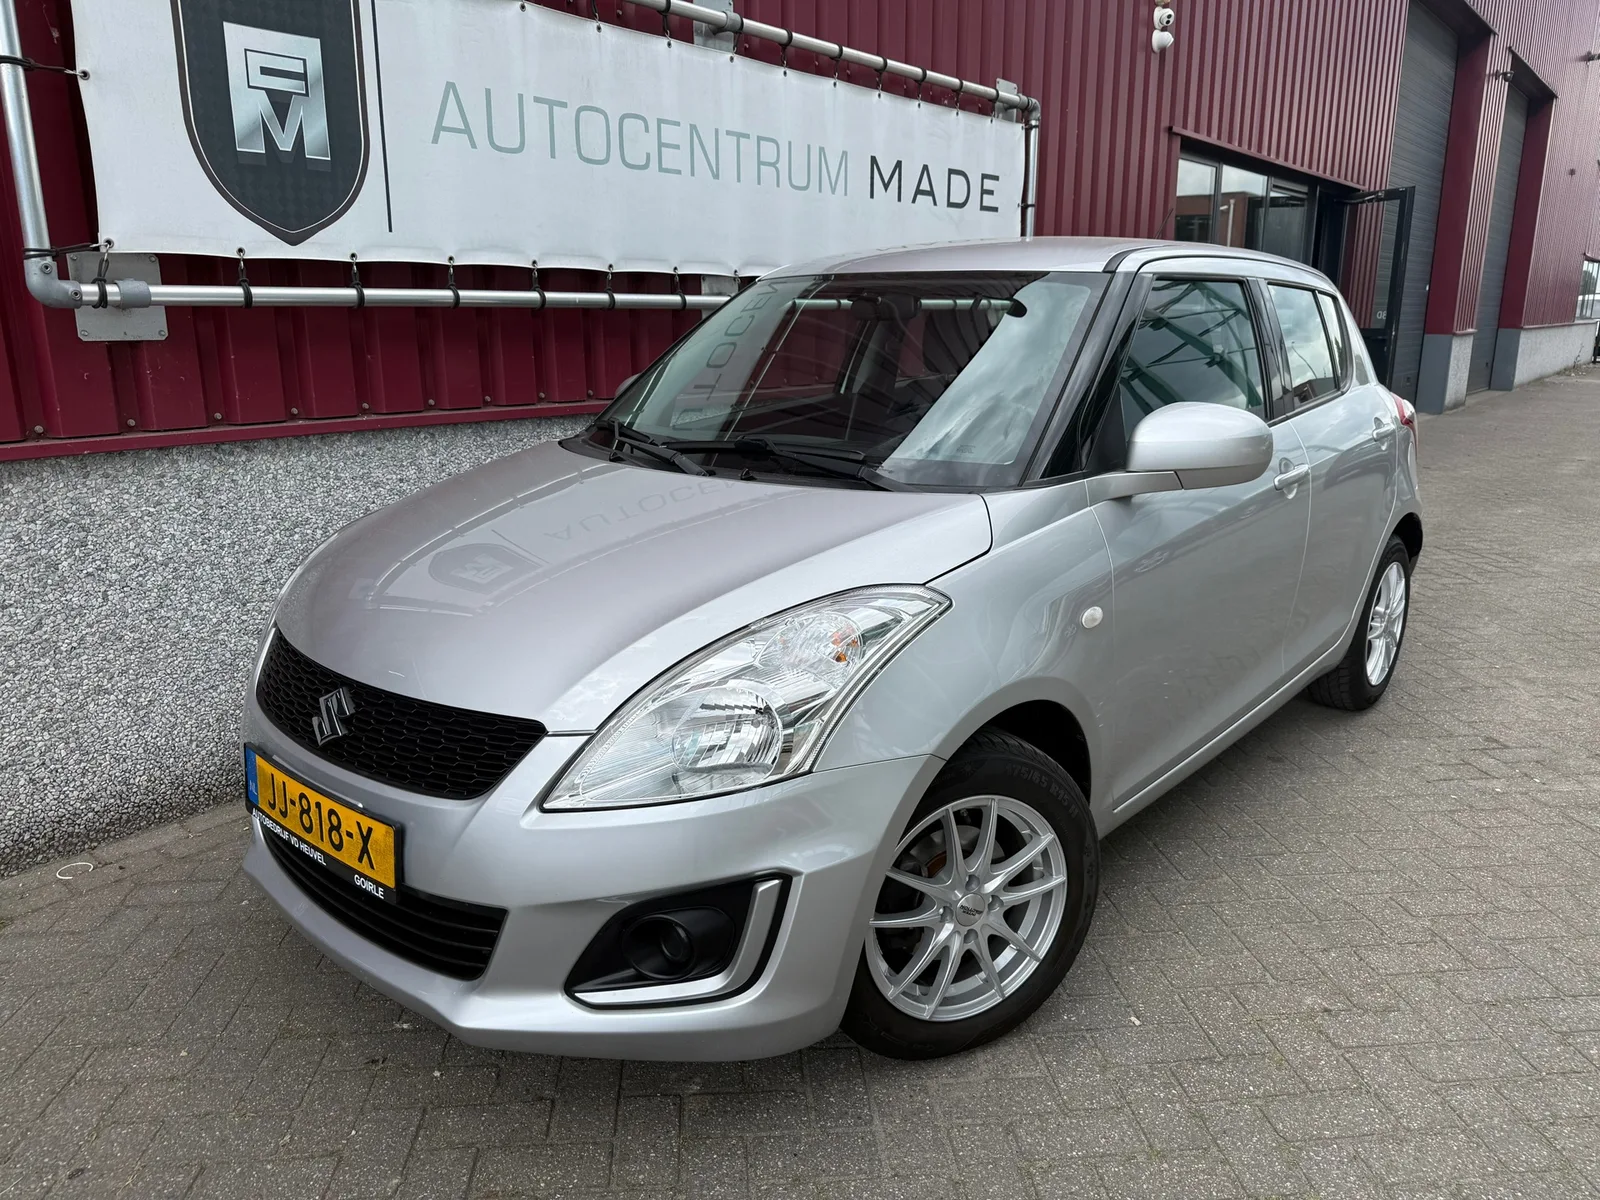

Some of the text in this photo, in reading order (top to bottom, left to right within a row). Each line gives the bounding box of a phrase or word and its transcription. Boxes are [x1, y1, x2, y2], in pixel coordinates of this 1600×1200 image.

[431, 81, 1000, 213] AUTOCENTRUM MADE
[252, 807, 291, 841] AUTOBEDRIJF
[300, 841, 327, 866] HEUVEL
[268, 773, 375, 870] JJ-818-X
[354, 874, 385, 900] GOIRLE
